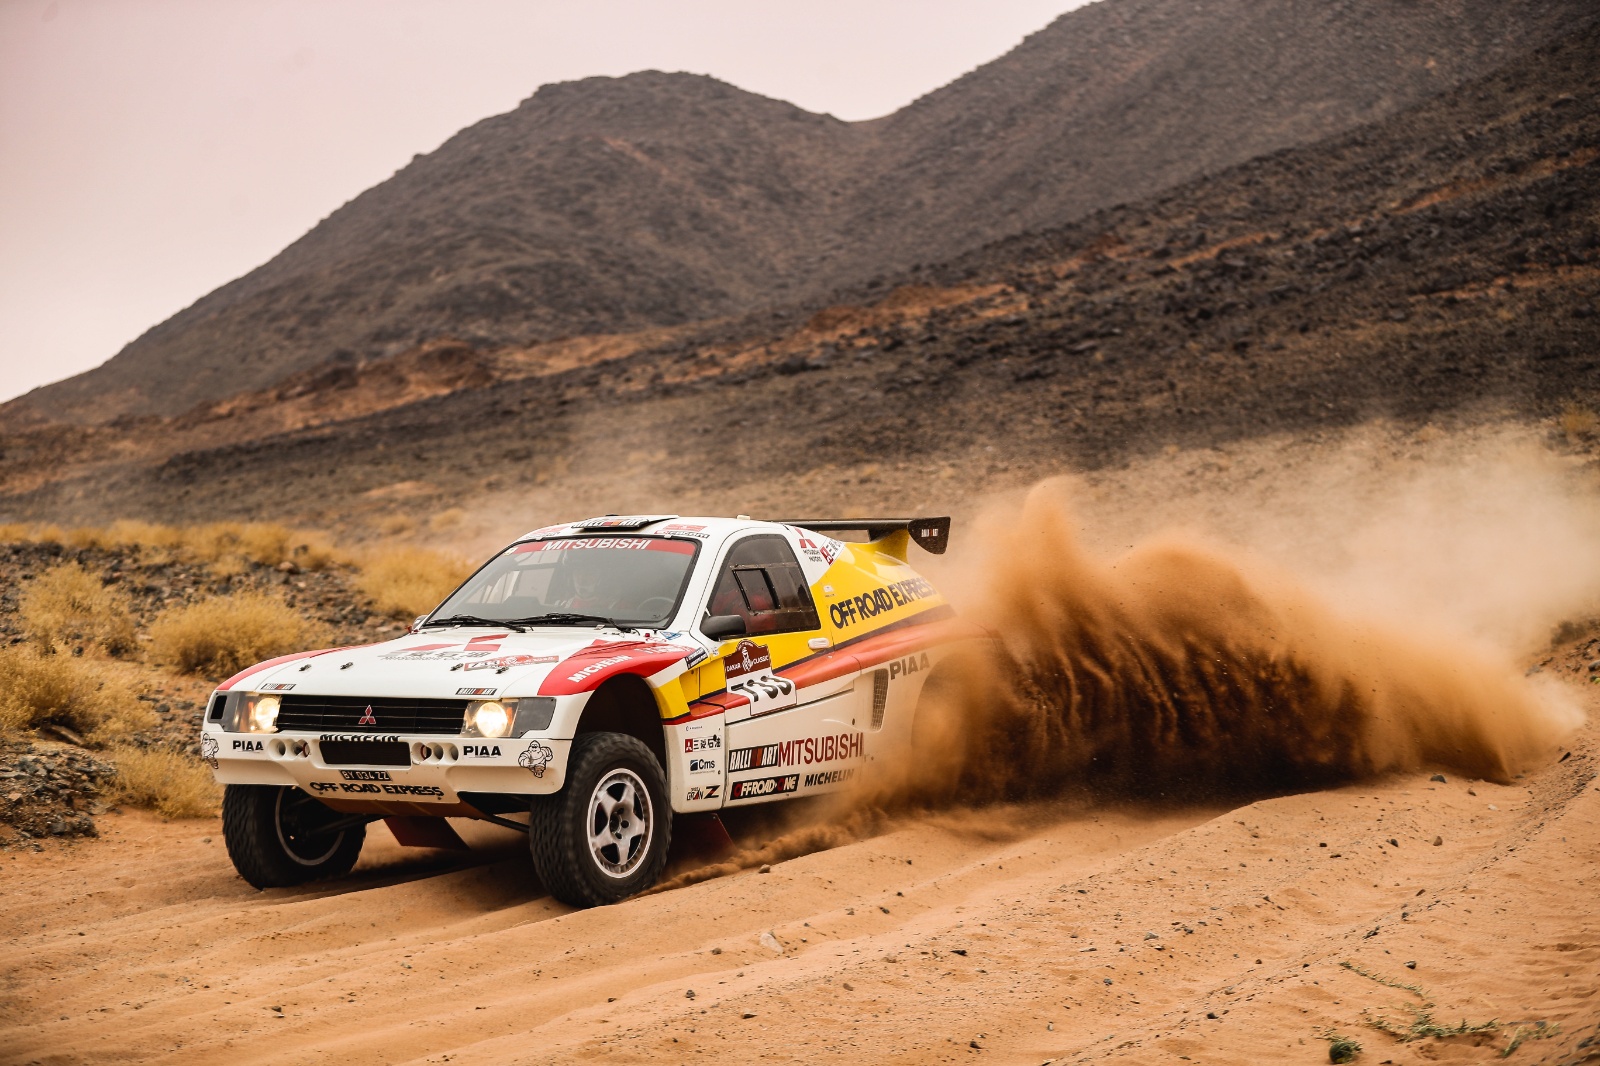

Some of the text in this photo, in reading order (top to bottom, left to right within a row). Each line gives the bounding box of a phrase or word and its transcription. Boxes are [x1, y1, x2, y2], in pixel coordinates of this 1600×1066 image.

[541, 538, 652, 551] MITSUBISHI
[830, 599, 856, 629] OFF
[854, 588, 893, 620] ROAD
[567, 654, 633, 683] MICHELIN
[889, 652, 930, 680] PIAA
[232, 740, 264, 751] PIAA
[463, 745, 502, 756] PIAA
[778, 732, 864, 767] MITSUBISHI
[698, 759, 716, 770] Cms
[356, 771, 375, 779] 034
[804, 768, 855, 787] MICHELIN
[310, 782, 444, 797] OFF ROAD EXPRESS
